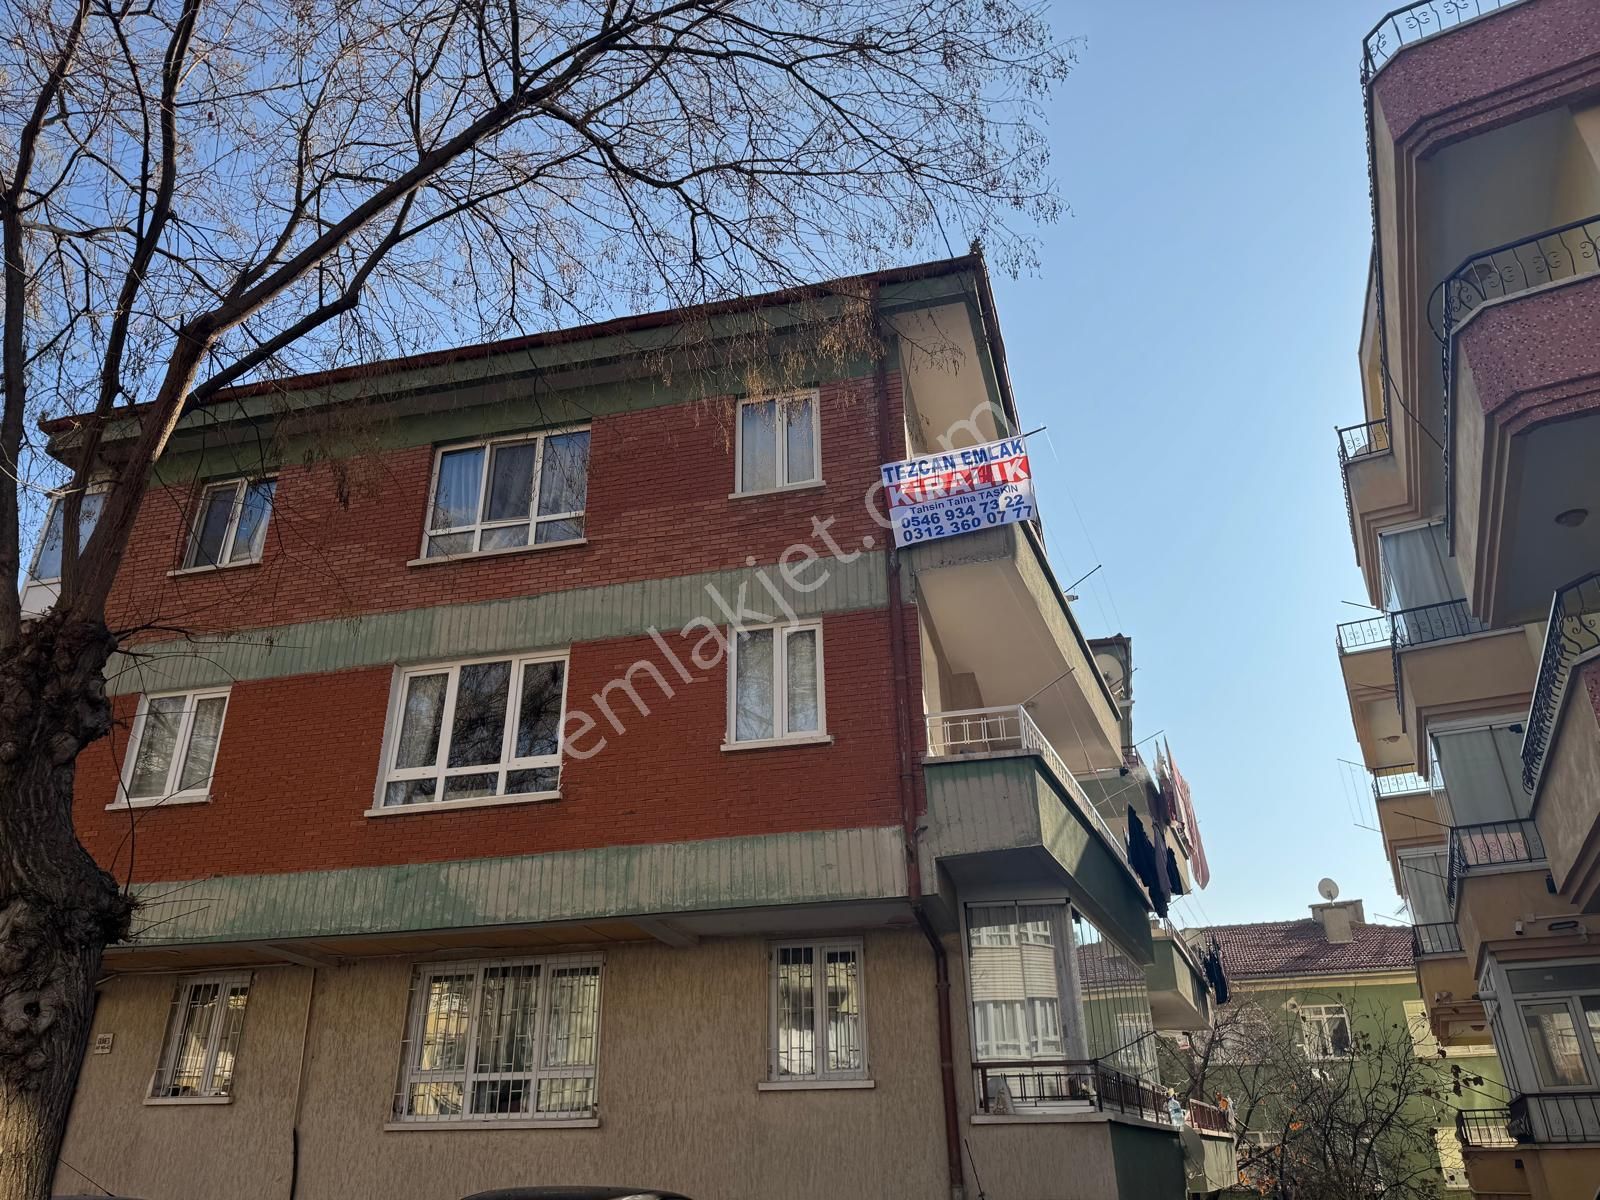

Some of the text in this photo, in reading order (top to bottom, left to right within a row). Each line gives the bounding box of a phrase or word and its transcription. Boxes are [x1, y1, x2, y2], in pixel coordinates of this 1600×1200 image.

[883, 439, 1024, 483] TEZCAN EMLAK
[902, 494, 1025, 529] 0546 934 73 22
[909, 501, 945, 515] Tahsin
[948, 494, 976, 507] Talha
[903, 505, 1032, 542] 0312 360 07 77
